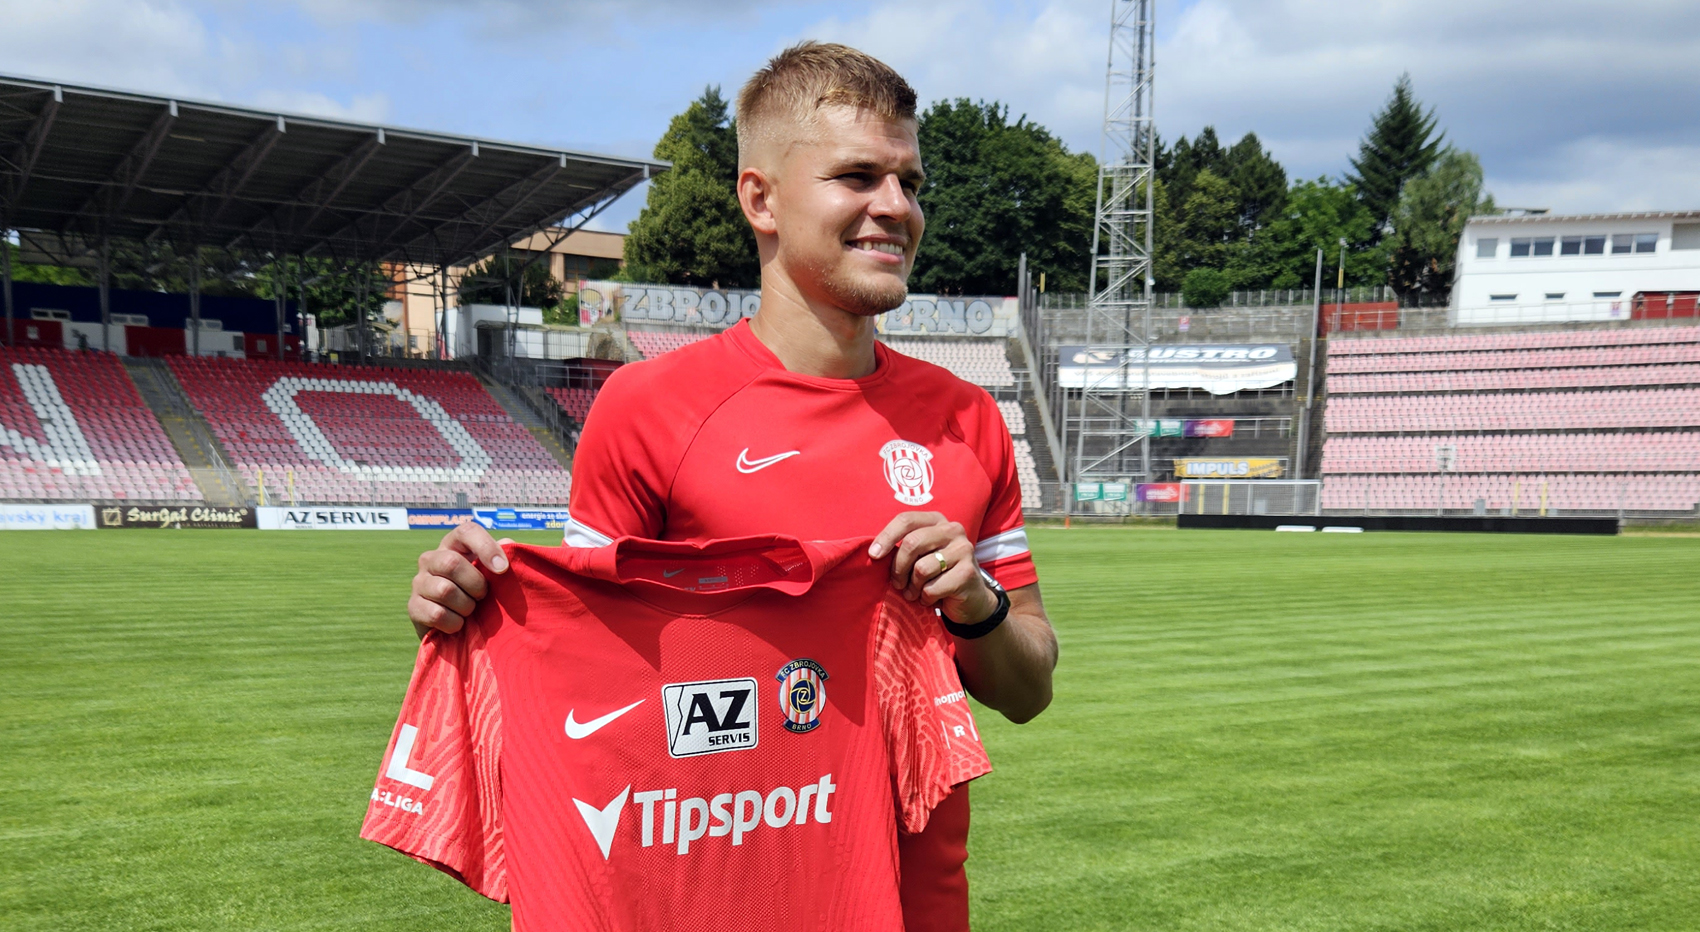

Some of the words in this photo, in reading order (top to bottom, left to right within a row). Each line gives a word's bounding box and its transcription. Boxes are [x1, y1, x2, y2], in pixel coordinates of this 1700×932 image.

[1186, 461, 1249, 476] IMPULS
[52, 510, 88, 526] kraj
[284, 511, 313, 525] AZ
[315, 511, 391, 525] SERVIS
[780, 669, 790, 679] FC
[789, 660, 826, 679] ZBROJOVKA
[800, 690, 807, 702] Z
[934, 691, 965, 706] homo
[682, 689, 752, 735] AZ
[791, 723, 812, 731] BRNO
[708, 732, 750, 747] SERVIS
[633, 772, 837, 856] Tipsport
